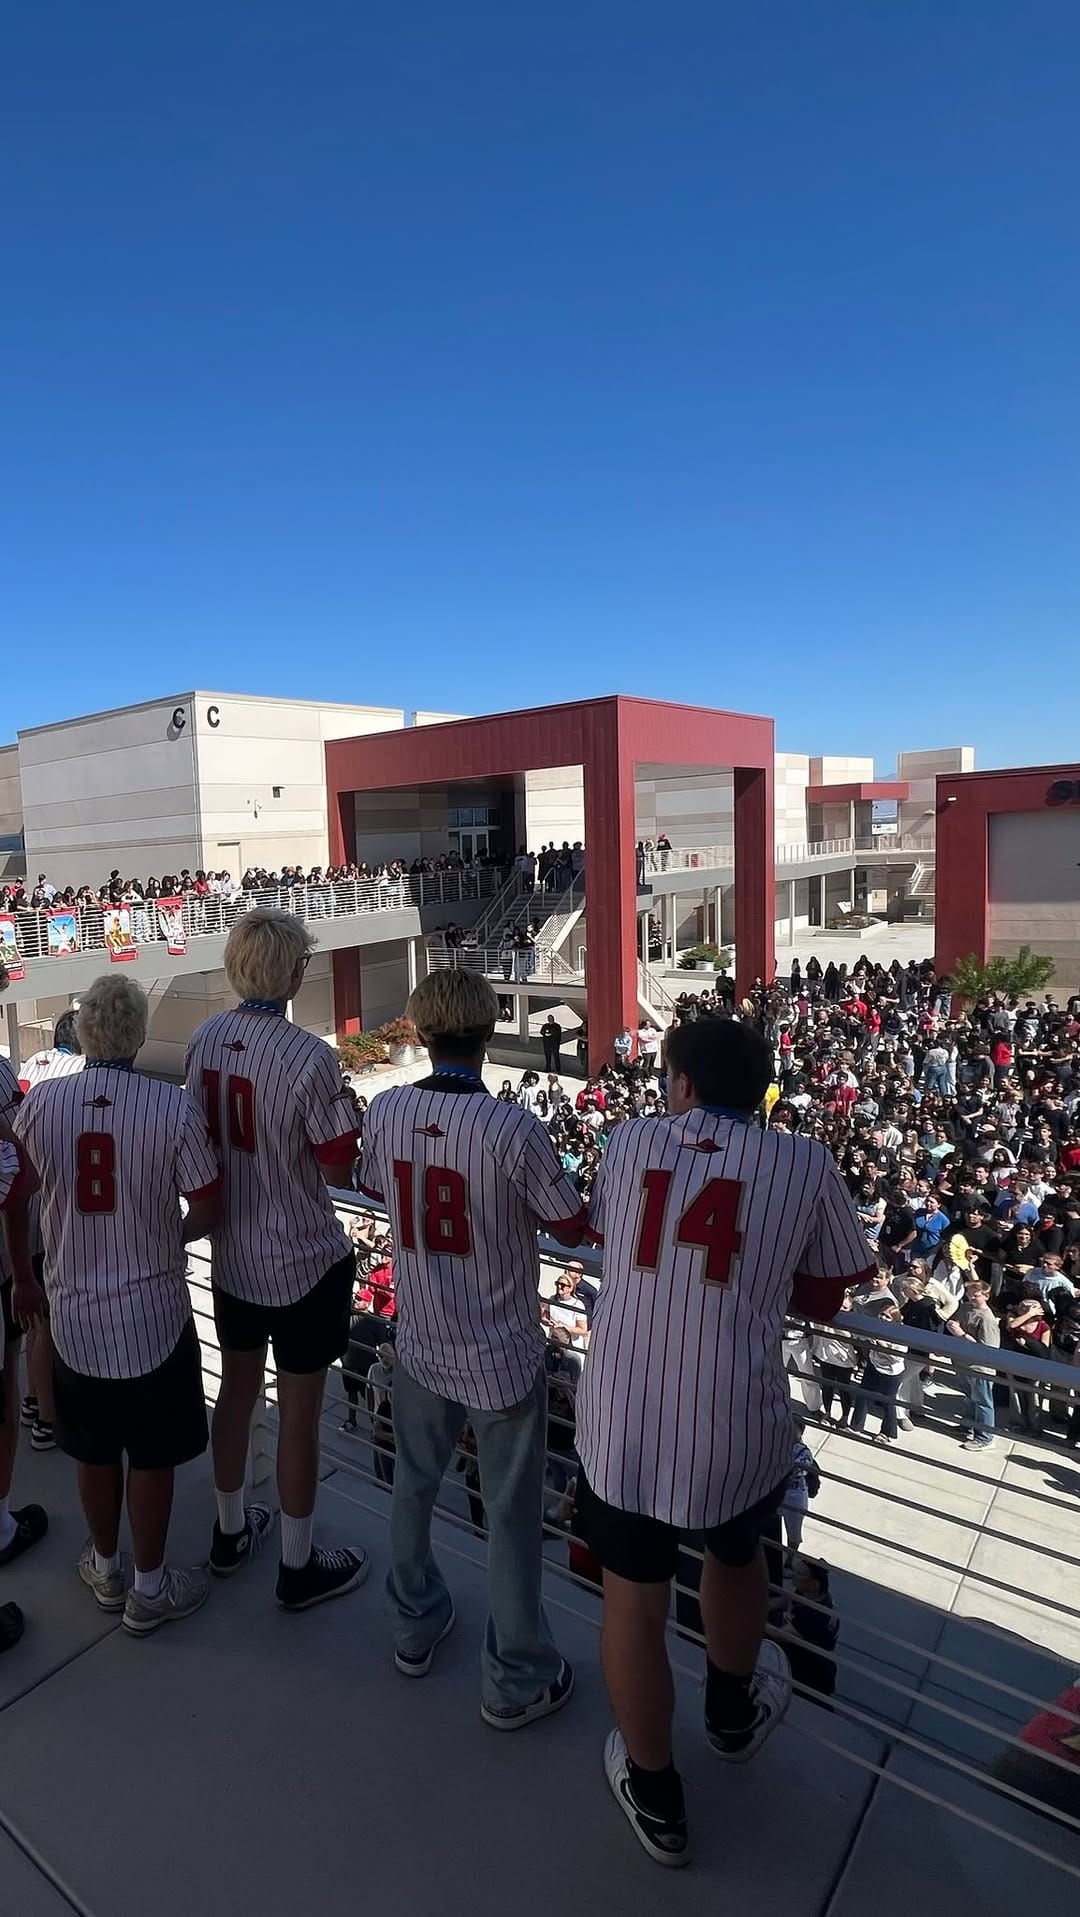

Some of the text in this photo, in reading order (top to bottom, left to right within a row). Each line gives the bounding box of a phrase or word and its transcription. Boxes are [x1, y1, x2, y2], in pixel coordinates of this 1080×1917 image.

[172, 707, 186, 729] C
[207, 705, 220, 728] C
[202, 1068, 256, 1154] 10
[76, 1131, 118, 1216] 8
[392, 1159, 473, 1259] 18
[632, 1168, 747, 1290] 14
